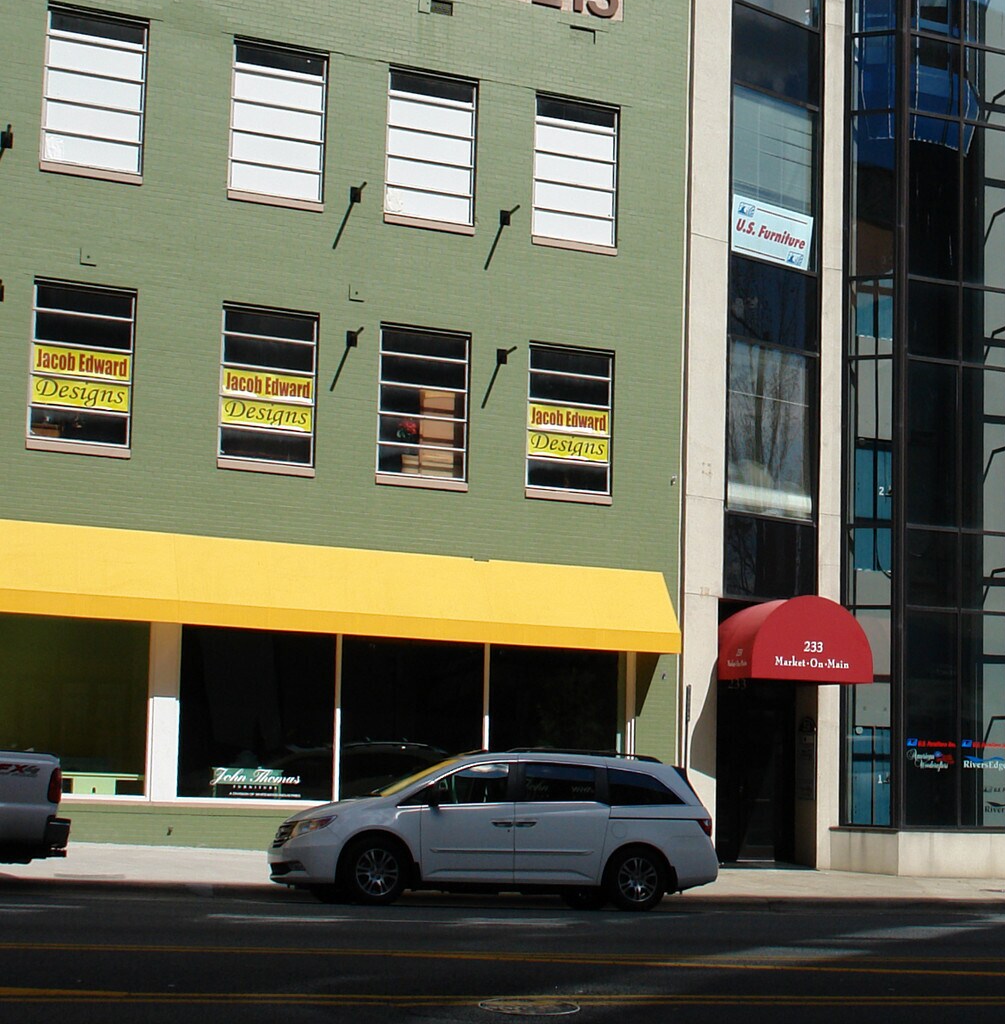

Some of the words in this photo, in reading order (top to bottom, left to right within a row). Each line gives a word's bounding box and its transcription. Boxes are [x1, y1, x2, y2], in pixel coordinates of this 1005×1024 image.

[735, 218, 756, 236] U.S.
[757, 225, 806, 249] Furniture
[37, 349, 76, 371] Jacob
[79, 353, 128, 377] Edward
[36, 377, 125, 407] Designs
[226, 372, 262, 394] Jacob
[265, 377, 311, 398] Edward
[225, 400, 308, 426] Designs
[531, 407, 564, 426] Jacob
[566, 411, 607, 431] Edward
[530, 433, 605, 456] Designs
[803, 640, 824, 653] 233
[209, 767, 247, 785] John
[249, 769, 301, 785] Thomas
